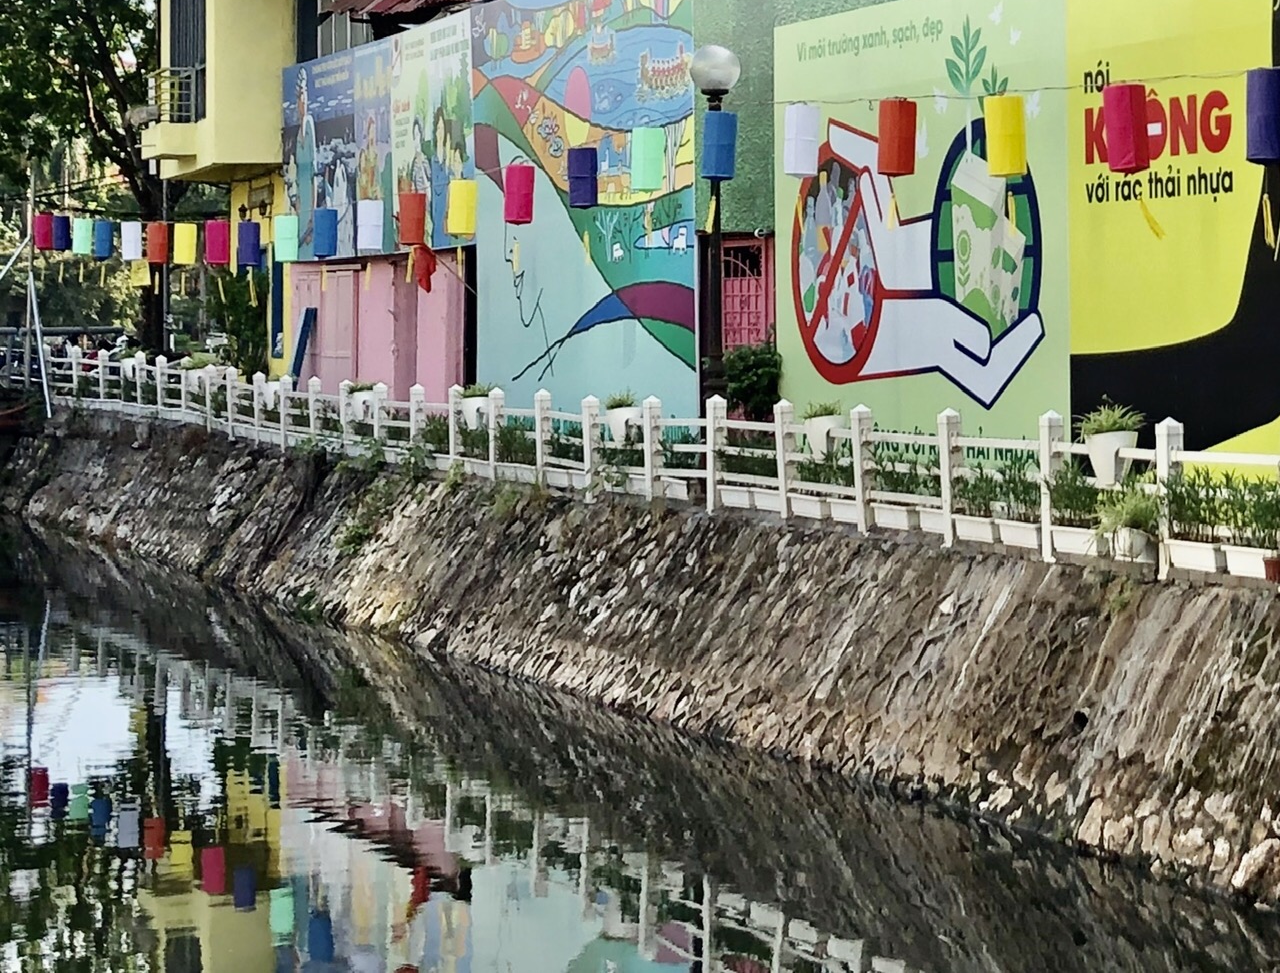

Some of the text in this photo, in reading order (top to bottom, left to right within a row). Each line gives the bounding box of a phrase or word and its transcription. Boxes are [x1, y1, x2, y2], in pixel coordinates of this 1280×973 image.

[808, 38, 826, 60] môi
[827, 34, 860, 57] trường
[862, 25, 890, 49] xanh,
[892, 19, 920, 50] sạch,
[922, 16, 944, 43] đẹp
[1083, 60, 1110, 94] nói
[1084, 88, 1232, 165] KÔNG
[1085, 164, 1234, 204] với rác thải nhựa
